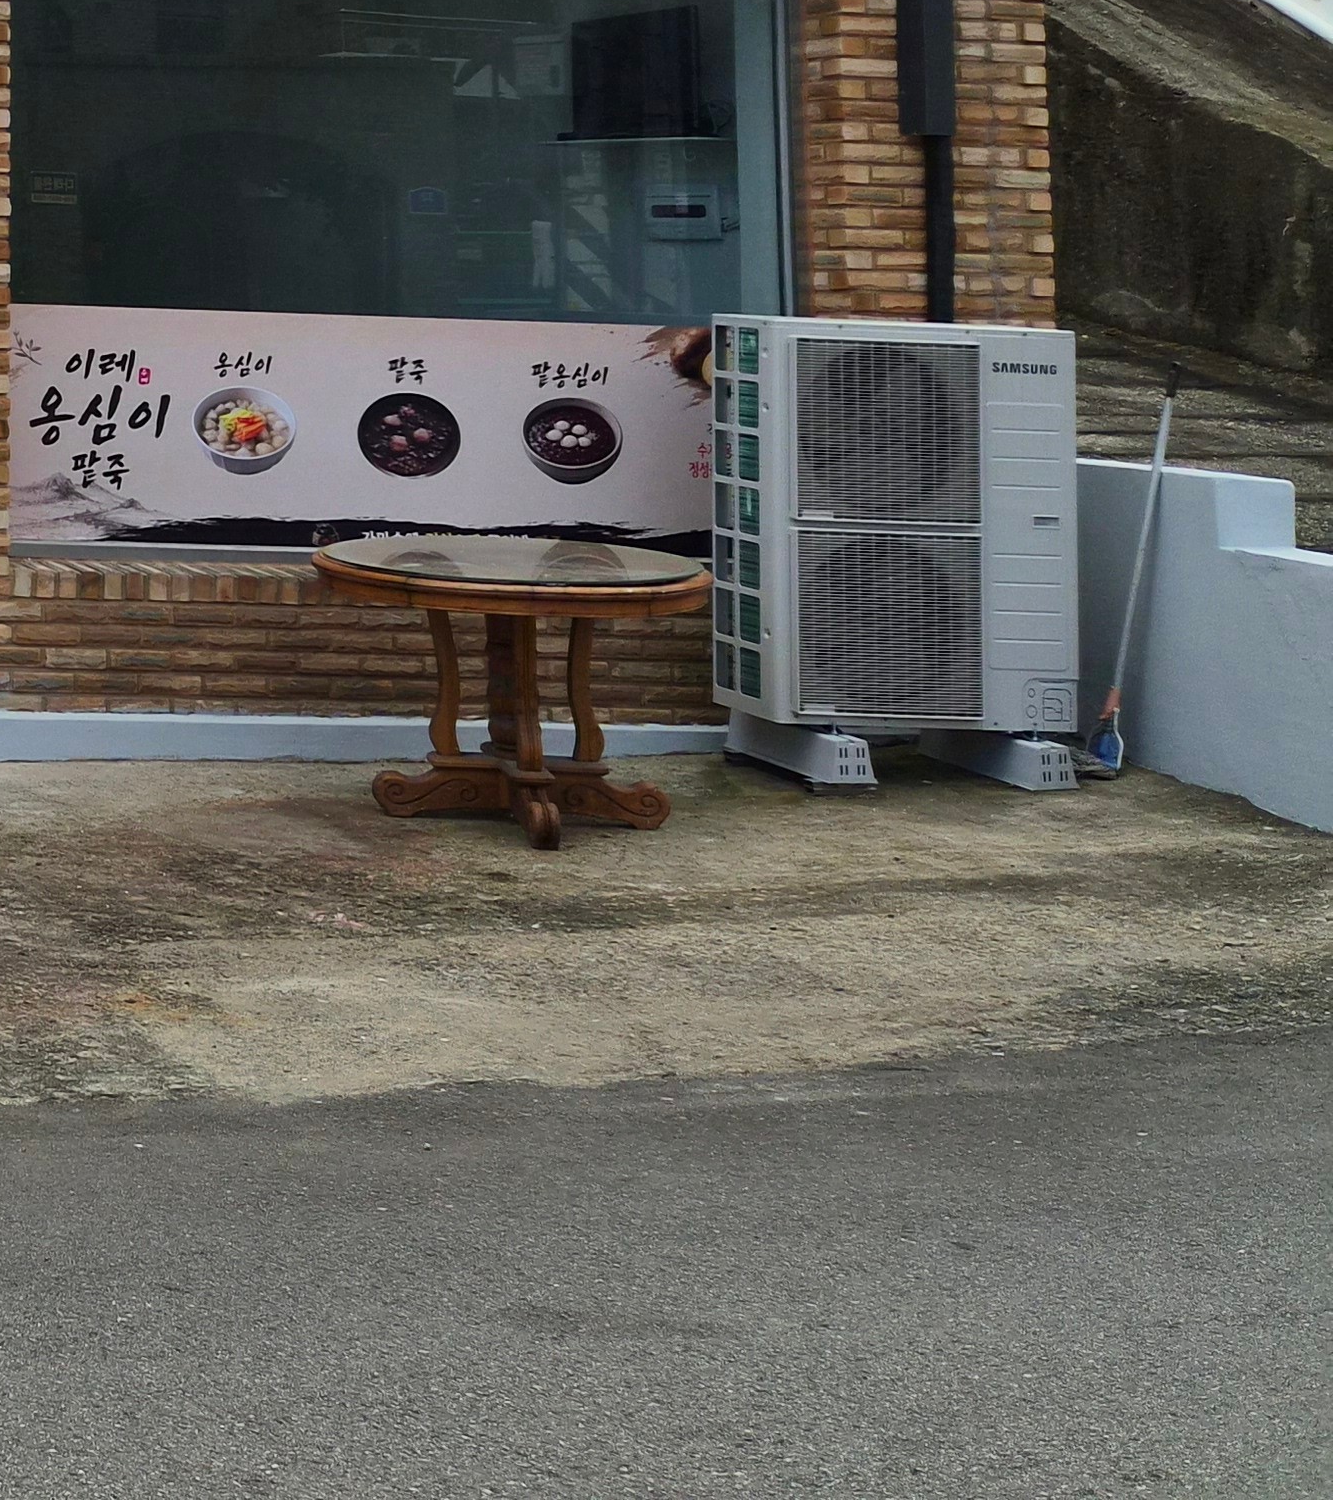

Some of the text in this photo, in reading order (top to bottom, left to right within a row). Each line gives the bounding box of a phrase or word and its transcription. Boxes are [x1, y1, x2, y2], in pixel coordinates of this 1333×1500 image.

[65, 348, 136, 382] 이레
[214, 351, 273, 378] 옹심이
[388, 356, 429, 385] 팥죽
[531, 361, 609, 389] 팥옹심이
[992, 361, 1058, 376] SAMSUNG
[29, 384, 171, 445] 옹심이
[71, 450, 130, 491] 팥죽
